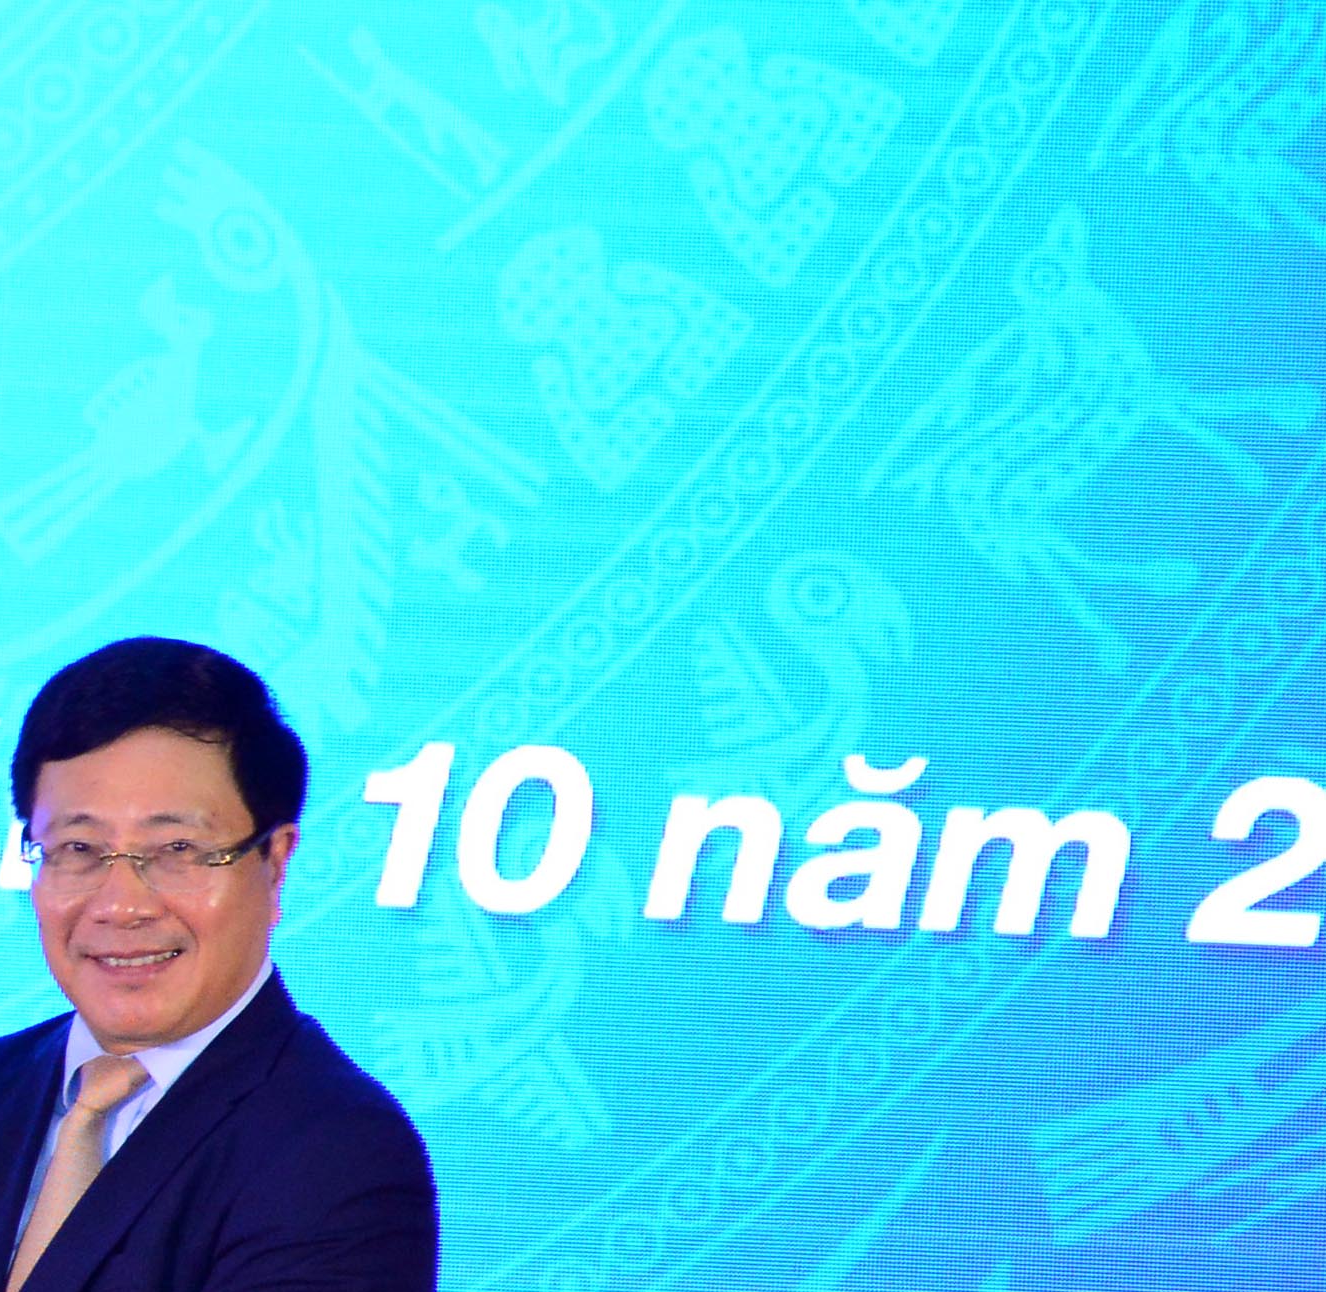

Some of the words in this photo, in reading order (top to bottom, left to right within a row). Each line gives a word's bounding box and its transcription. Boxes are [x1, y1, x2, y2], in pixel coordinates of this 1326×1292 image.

[361, 741, 595, 914] 10
[642, 752, 1132, 939] năm
[1185, 775, 1326, 948] 2
